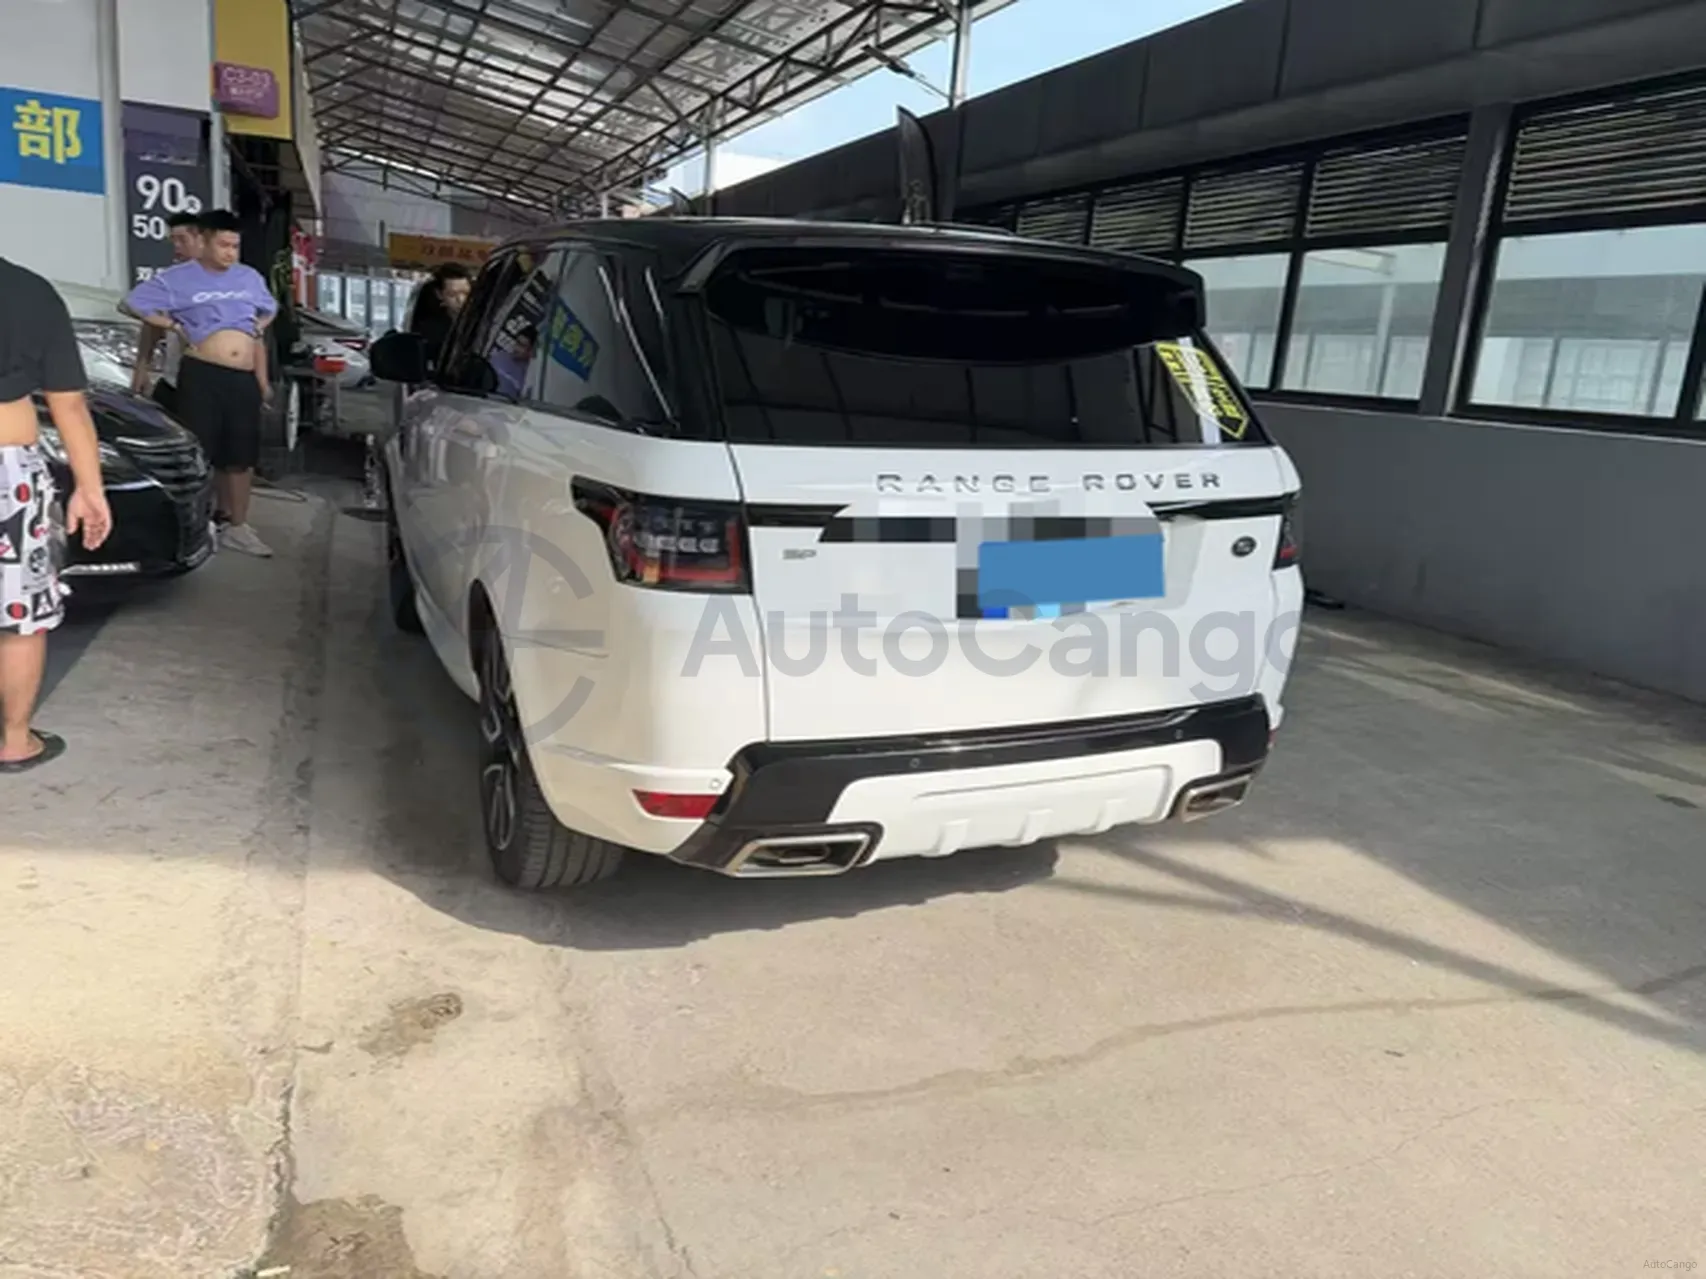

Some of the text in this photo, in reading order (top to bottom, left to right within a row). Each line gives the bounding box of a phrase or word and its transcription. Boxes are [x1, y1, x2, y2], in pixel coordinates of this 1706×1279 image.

[12, 100, 82, 164] 部
[876, 473, 1221, 492] RANGE ROVER
